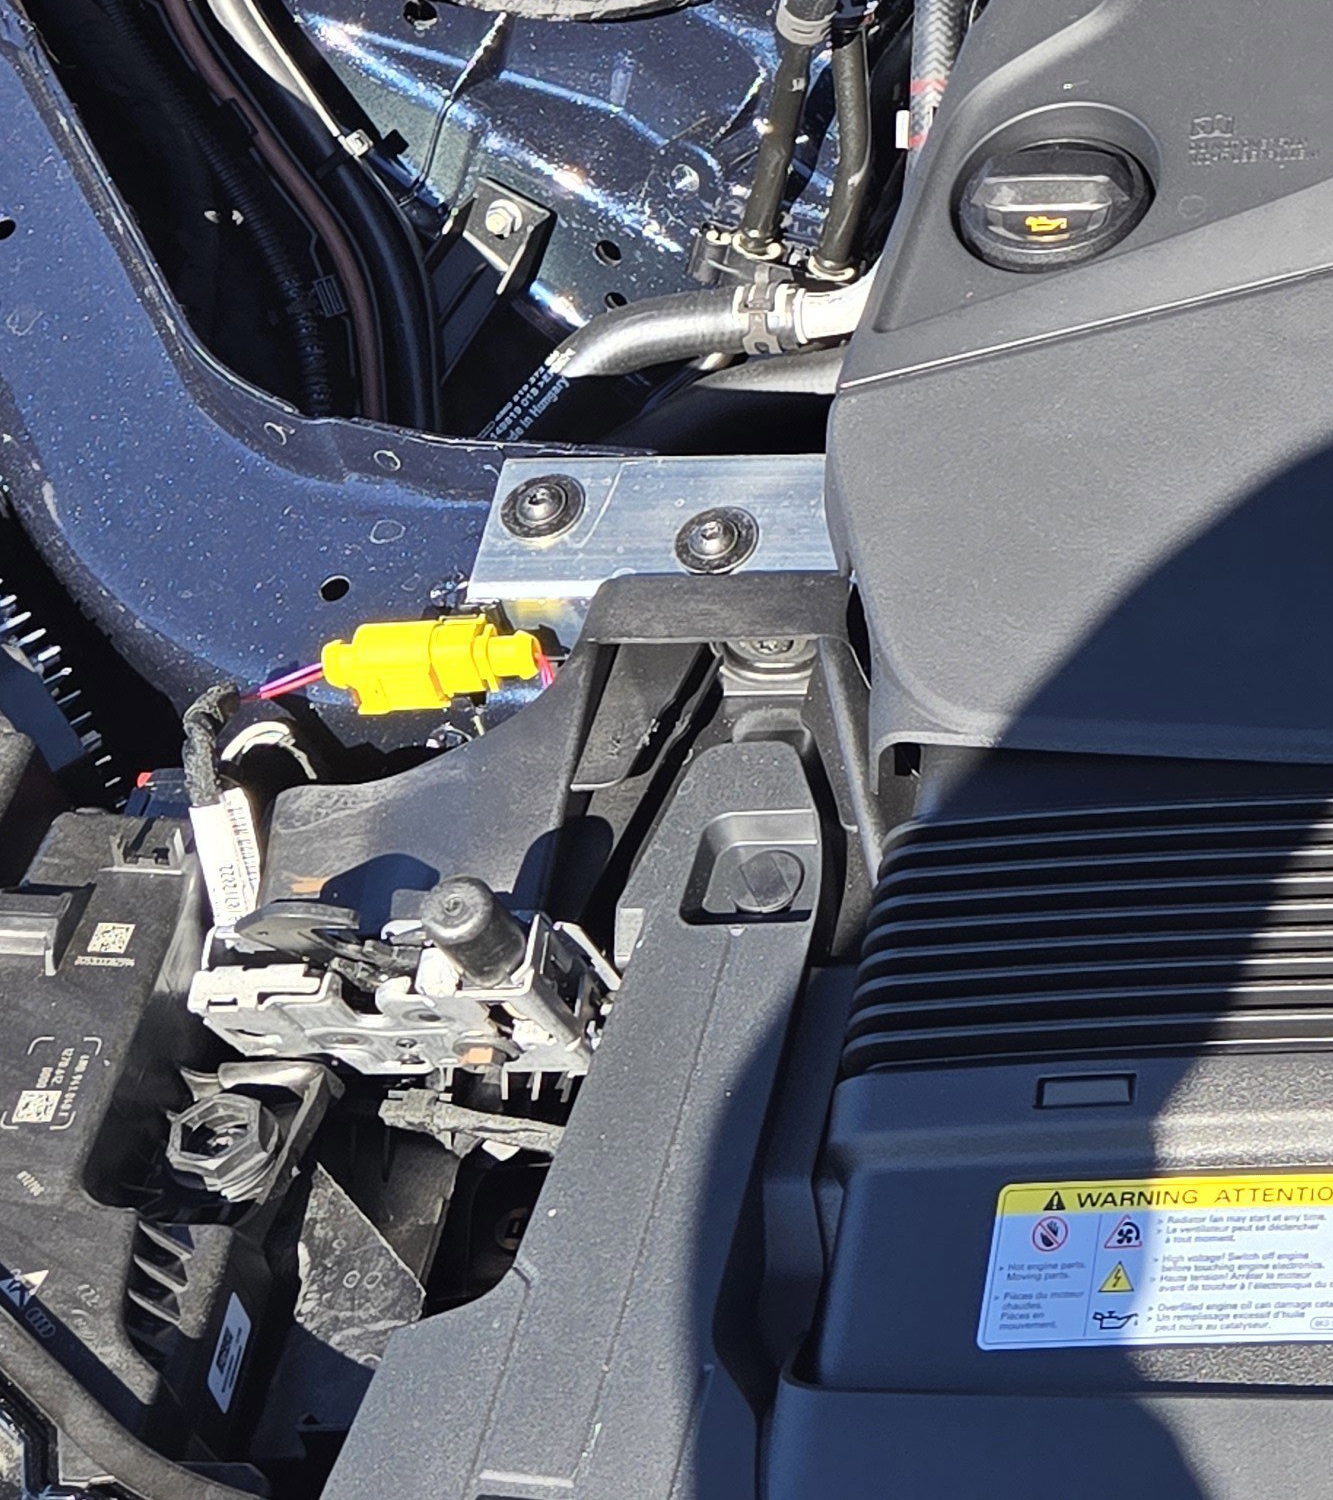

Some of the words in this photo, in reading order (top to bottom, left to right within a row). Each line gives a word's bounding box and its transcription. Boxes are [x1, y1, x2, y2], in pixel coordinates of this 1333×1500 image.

[529, 376, 570, 418] Hungary
[1077, 1190, 1198, 1207] WARNING
[1167, 1215, 1206, 1223] Radiator
[1209, 1215, 1224, 1223] fan
[1227, 1215, 1246, 1224] may
[1249, 1214, 1270, 1222] start
[1284, 1215, 1301, 1223] any
[1304, 1213, 1326, 1221] time.
[1167, 1226, 1177, 1234] Le
[1180, 1225, 1229, 1233] ventilateur
[1232, 1225, 1253, 1234] peut
[1268, 1223, 1319, 1231] déclencher
[1174, 1235, 1192, 1243] tout
[1162, 1255, 1184, 1263] High
[1188, 1253, 1225, 1263] voltage!
[1228, 1252, 1259, 1261] Switch
[1262, 1252, 1274, 1260] off
[1277, 1252, 1309, 1261] engine
[1027, 1263, 1058, 1271] engine
[1060, 1261, 1085, 1269] parts.
[1162, 1264, 1191, 1272] before
[1194, 1263, 1234, 1272] touching
[1238, 1263, 1269, 1271] engine
[1007, 1272, 1041, 1281] Moving
[1160, 1274, 1187, 1282] Haute
[1190, 1273, 1228, 1281] tension!
[1159, 1284, 1184, 1292] avant
[1187, 1283, 1199, 1291] de
[1202, 1282, 1237, 1291] toucher
[1315, 1280, 1326, 1288] du
[1036, 1291, 1047, 1299] du
[1002, 1302, 1042, 1310] chaudes.
[1158, 1303, 1203, 1312] Overfilled
[1206, 1302, 1237, 1311] engine
[1240, 1301, 1252, 1309] oil
[1274, 1301, 1311, 1309] damage
[1233, 1311, 1271, 1319] excessif
[1000, 1321, 1056, 1329] mouvement.
[1155, 1324, 1176, 1332] peut
[1220, 1321, 1271, 1330] catalyseur.
